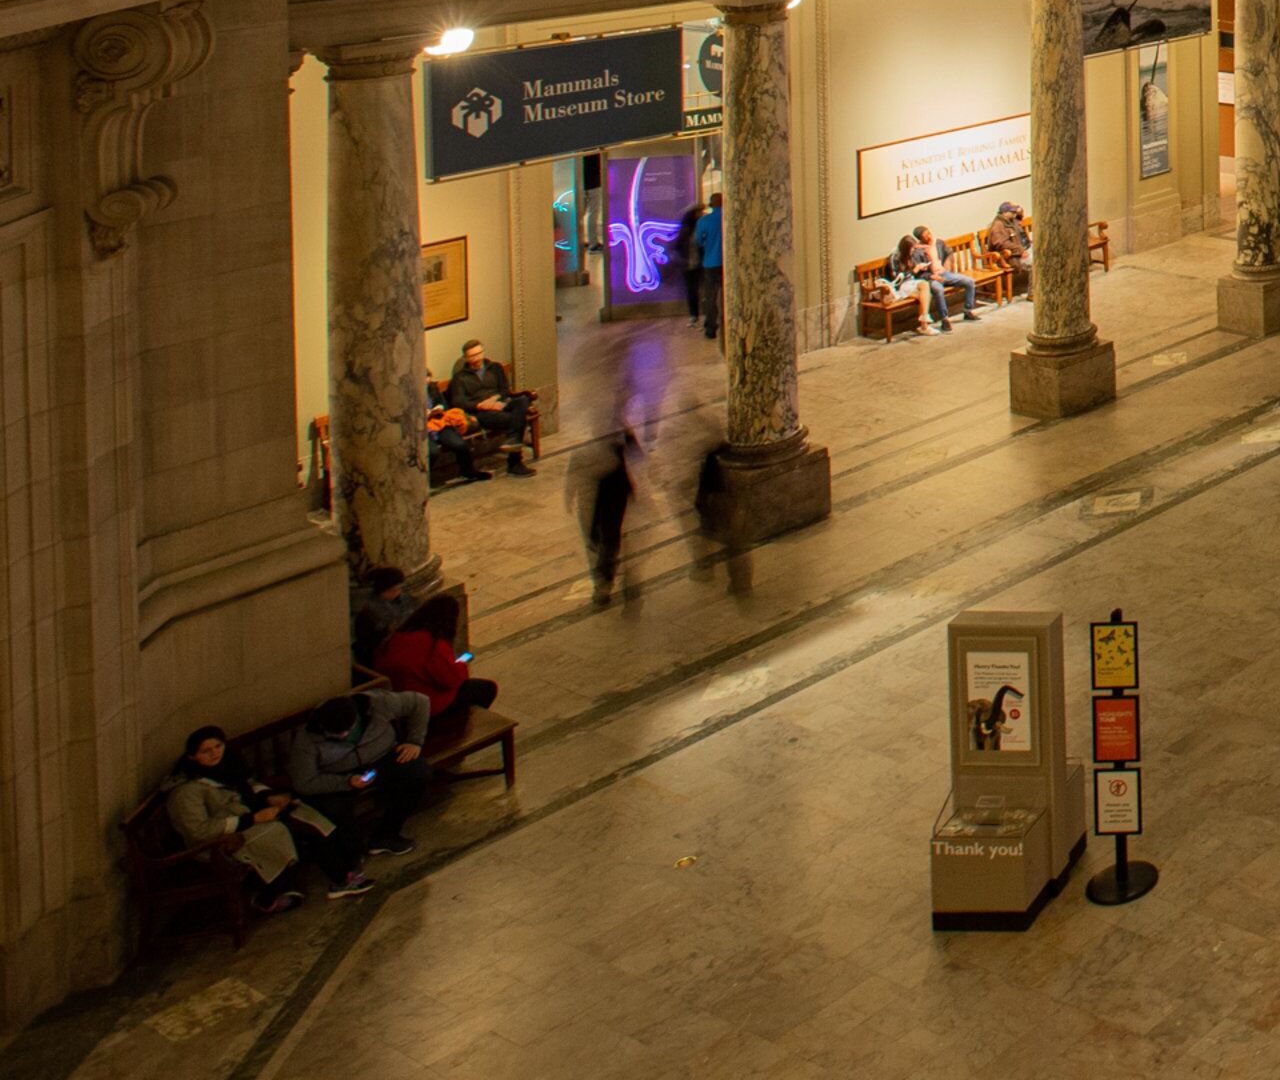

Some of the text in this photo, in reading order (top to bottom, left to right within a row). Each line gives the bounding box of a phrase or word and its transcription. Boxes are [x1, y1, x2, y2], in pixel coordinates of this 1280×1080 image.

[522, 69, 620, 100] Mammals
[522, 88, 665, 124] Museum Store
[896, 169, 933, 191] HALL
[936, 163, 954, 181] OF
[931, 841, 1024, 860] Thank you!
